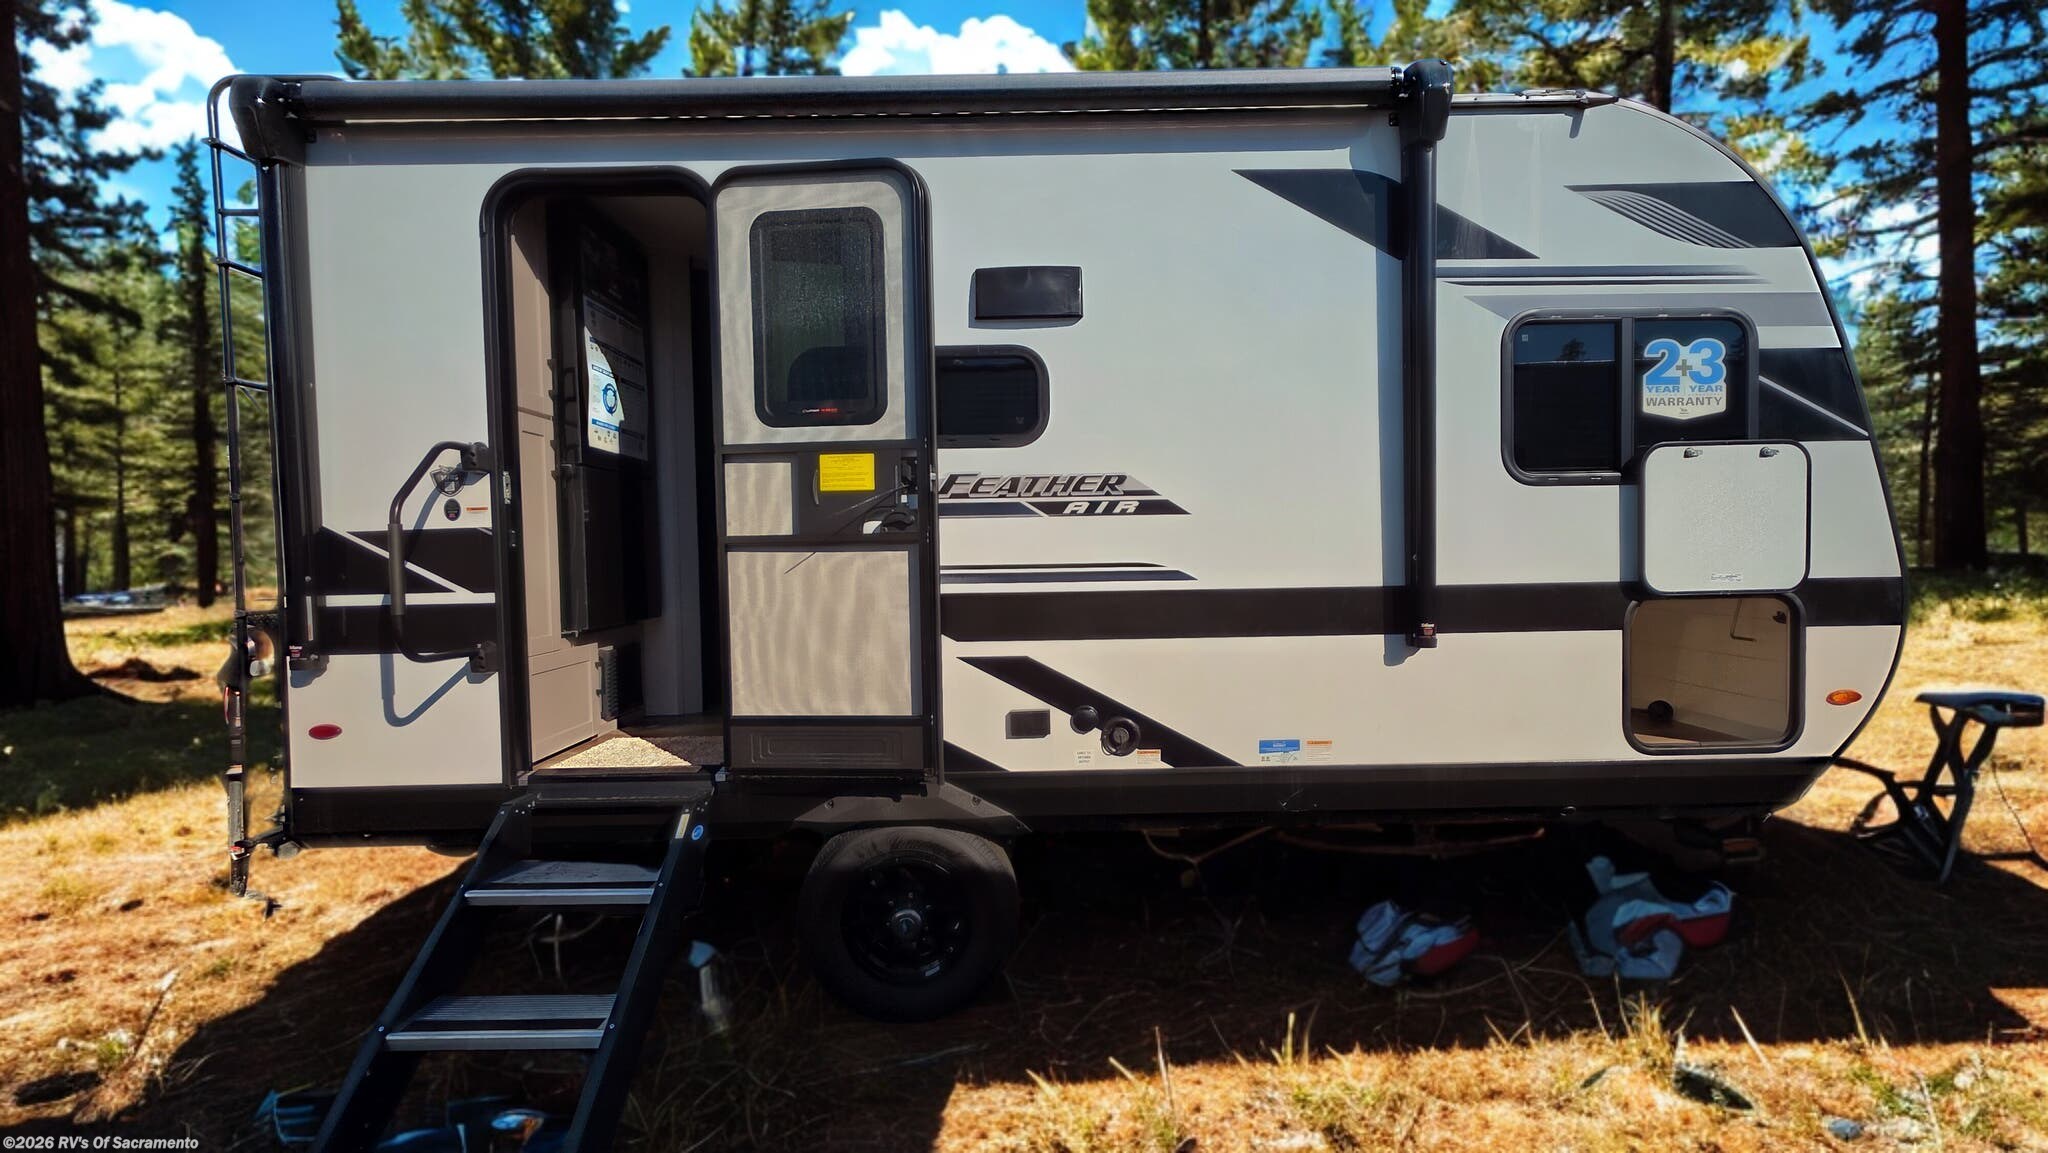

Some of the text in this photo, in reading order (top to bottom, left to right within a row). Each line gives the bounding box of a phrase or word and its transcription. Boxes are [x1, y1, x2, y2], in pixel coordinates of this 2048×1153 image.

[1646, 385, 1723, 393] YEAR YEAR
[1646, 396, 1723, 407] WARRANTY
[938, 472, 1128, 497] FEATHER
[1062, 500, 1141, 514] AIR
